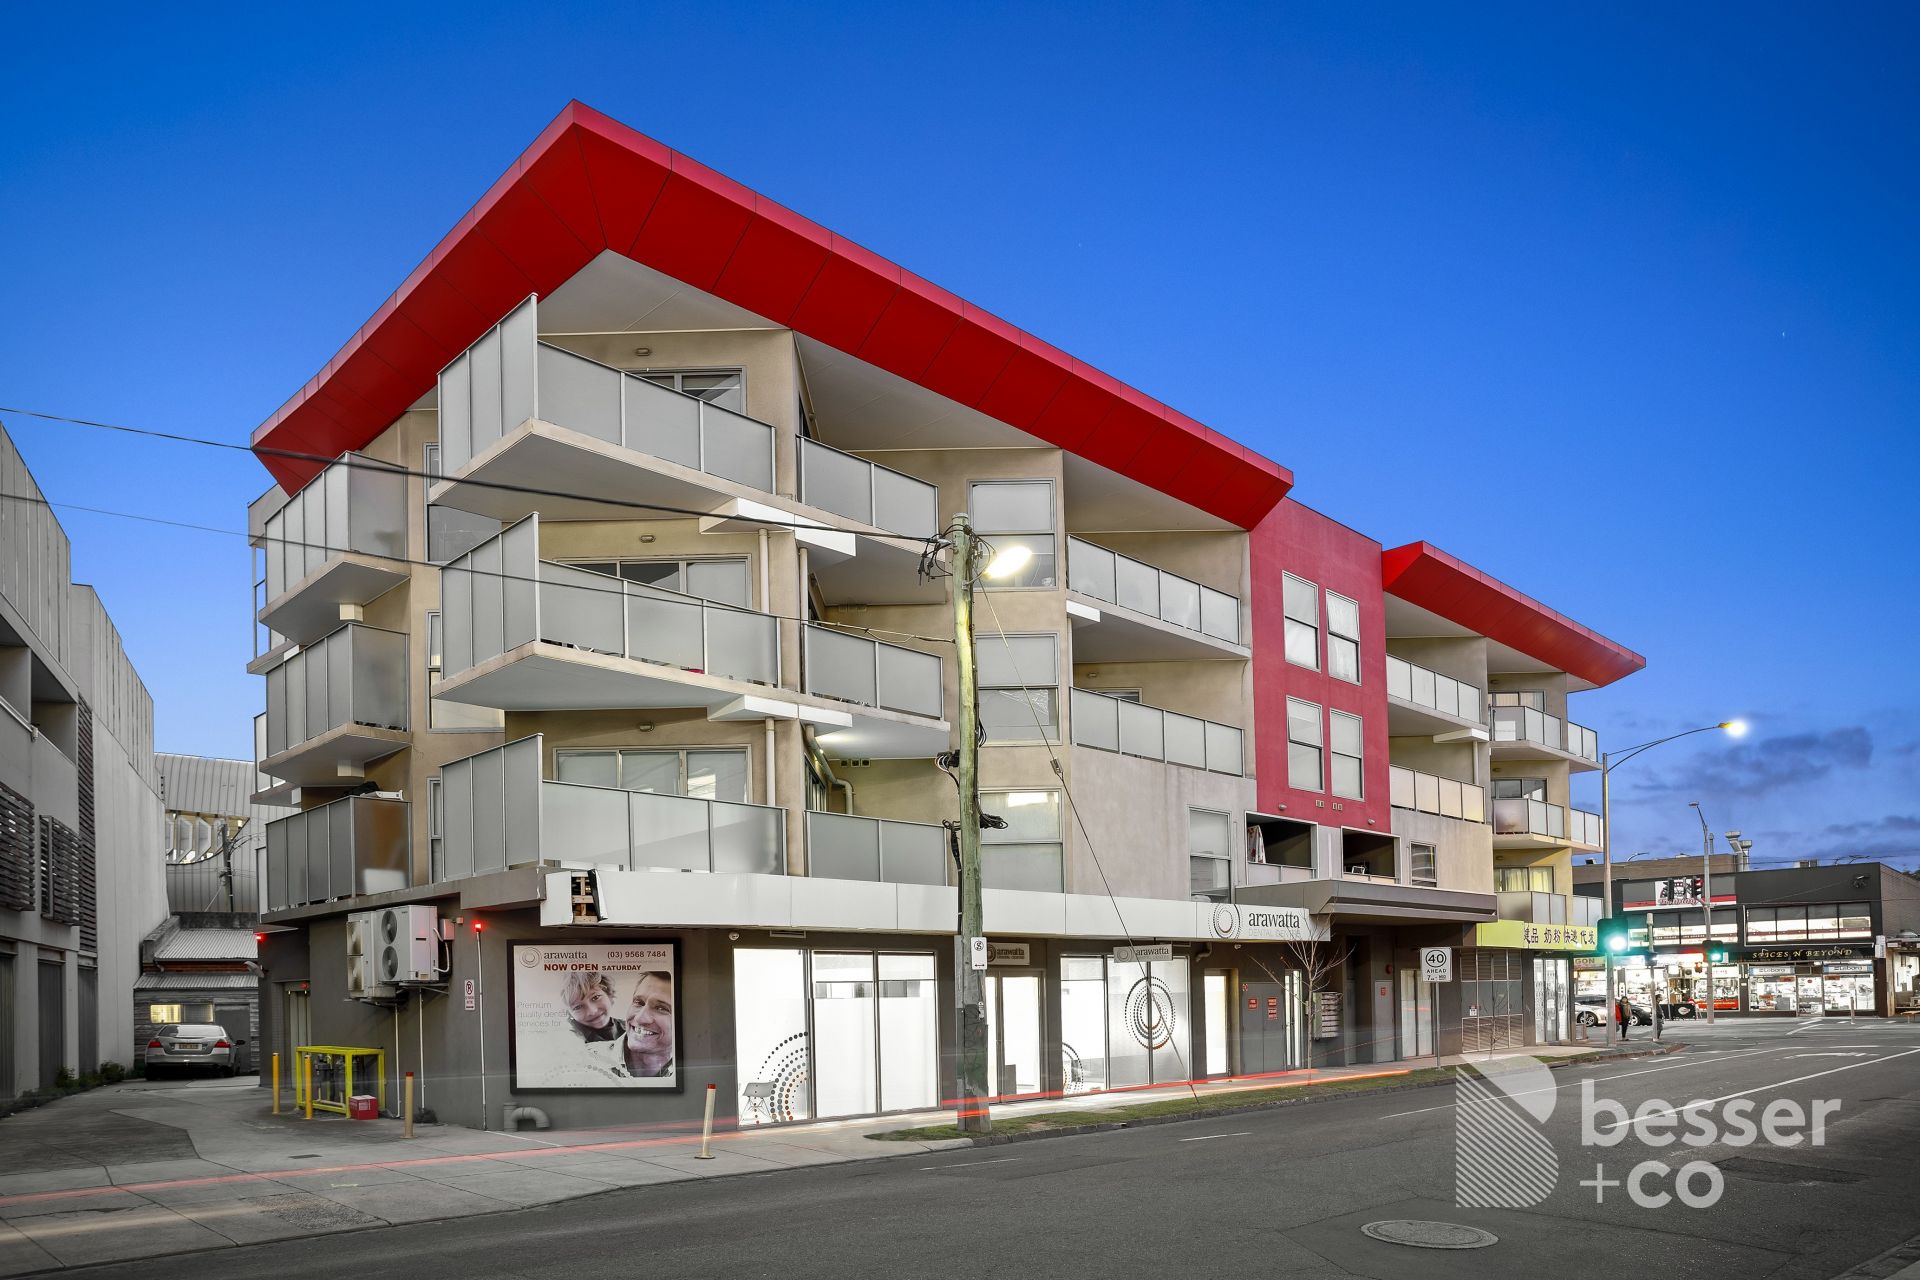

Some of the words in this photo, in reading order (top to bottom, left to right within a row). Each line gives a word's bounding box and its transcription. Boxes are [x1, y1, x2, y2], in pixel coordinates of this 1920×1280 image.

[1249, 911, 1300, 928] arawatta
[544, 950, 588, 960] arawatta
[607, 951, 623, 959] (03)
[625, 951, 645, 959] 9568
[1136, 947, 1170, 956] arawatta
[1805, 948, 1853, 957] BEYOND
[1428, 953, 1445, 964] 40
